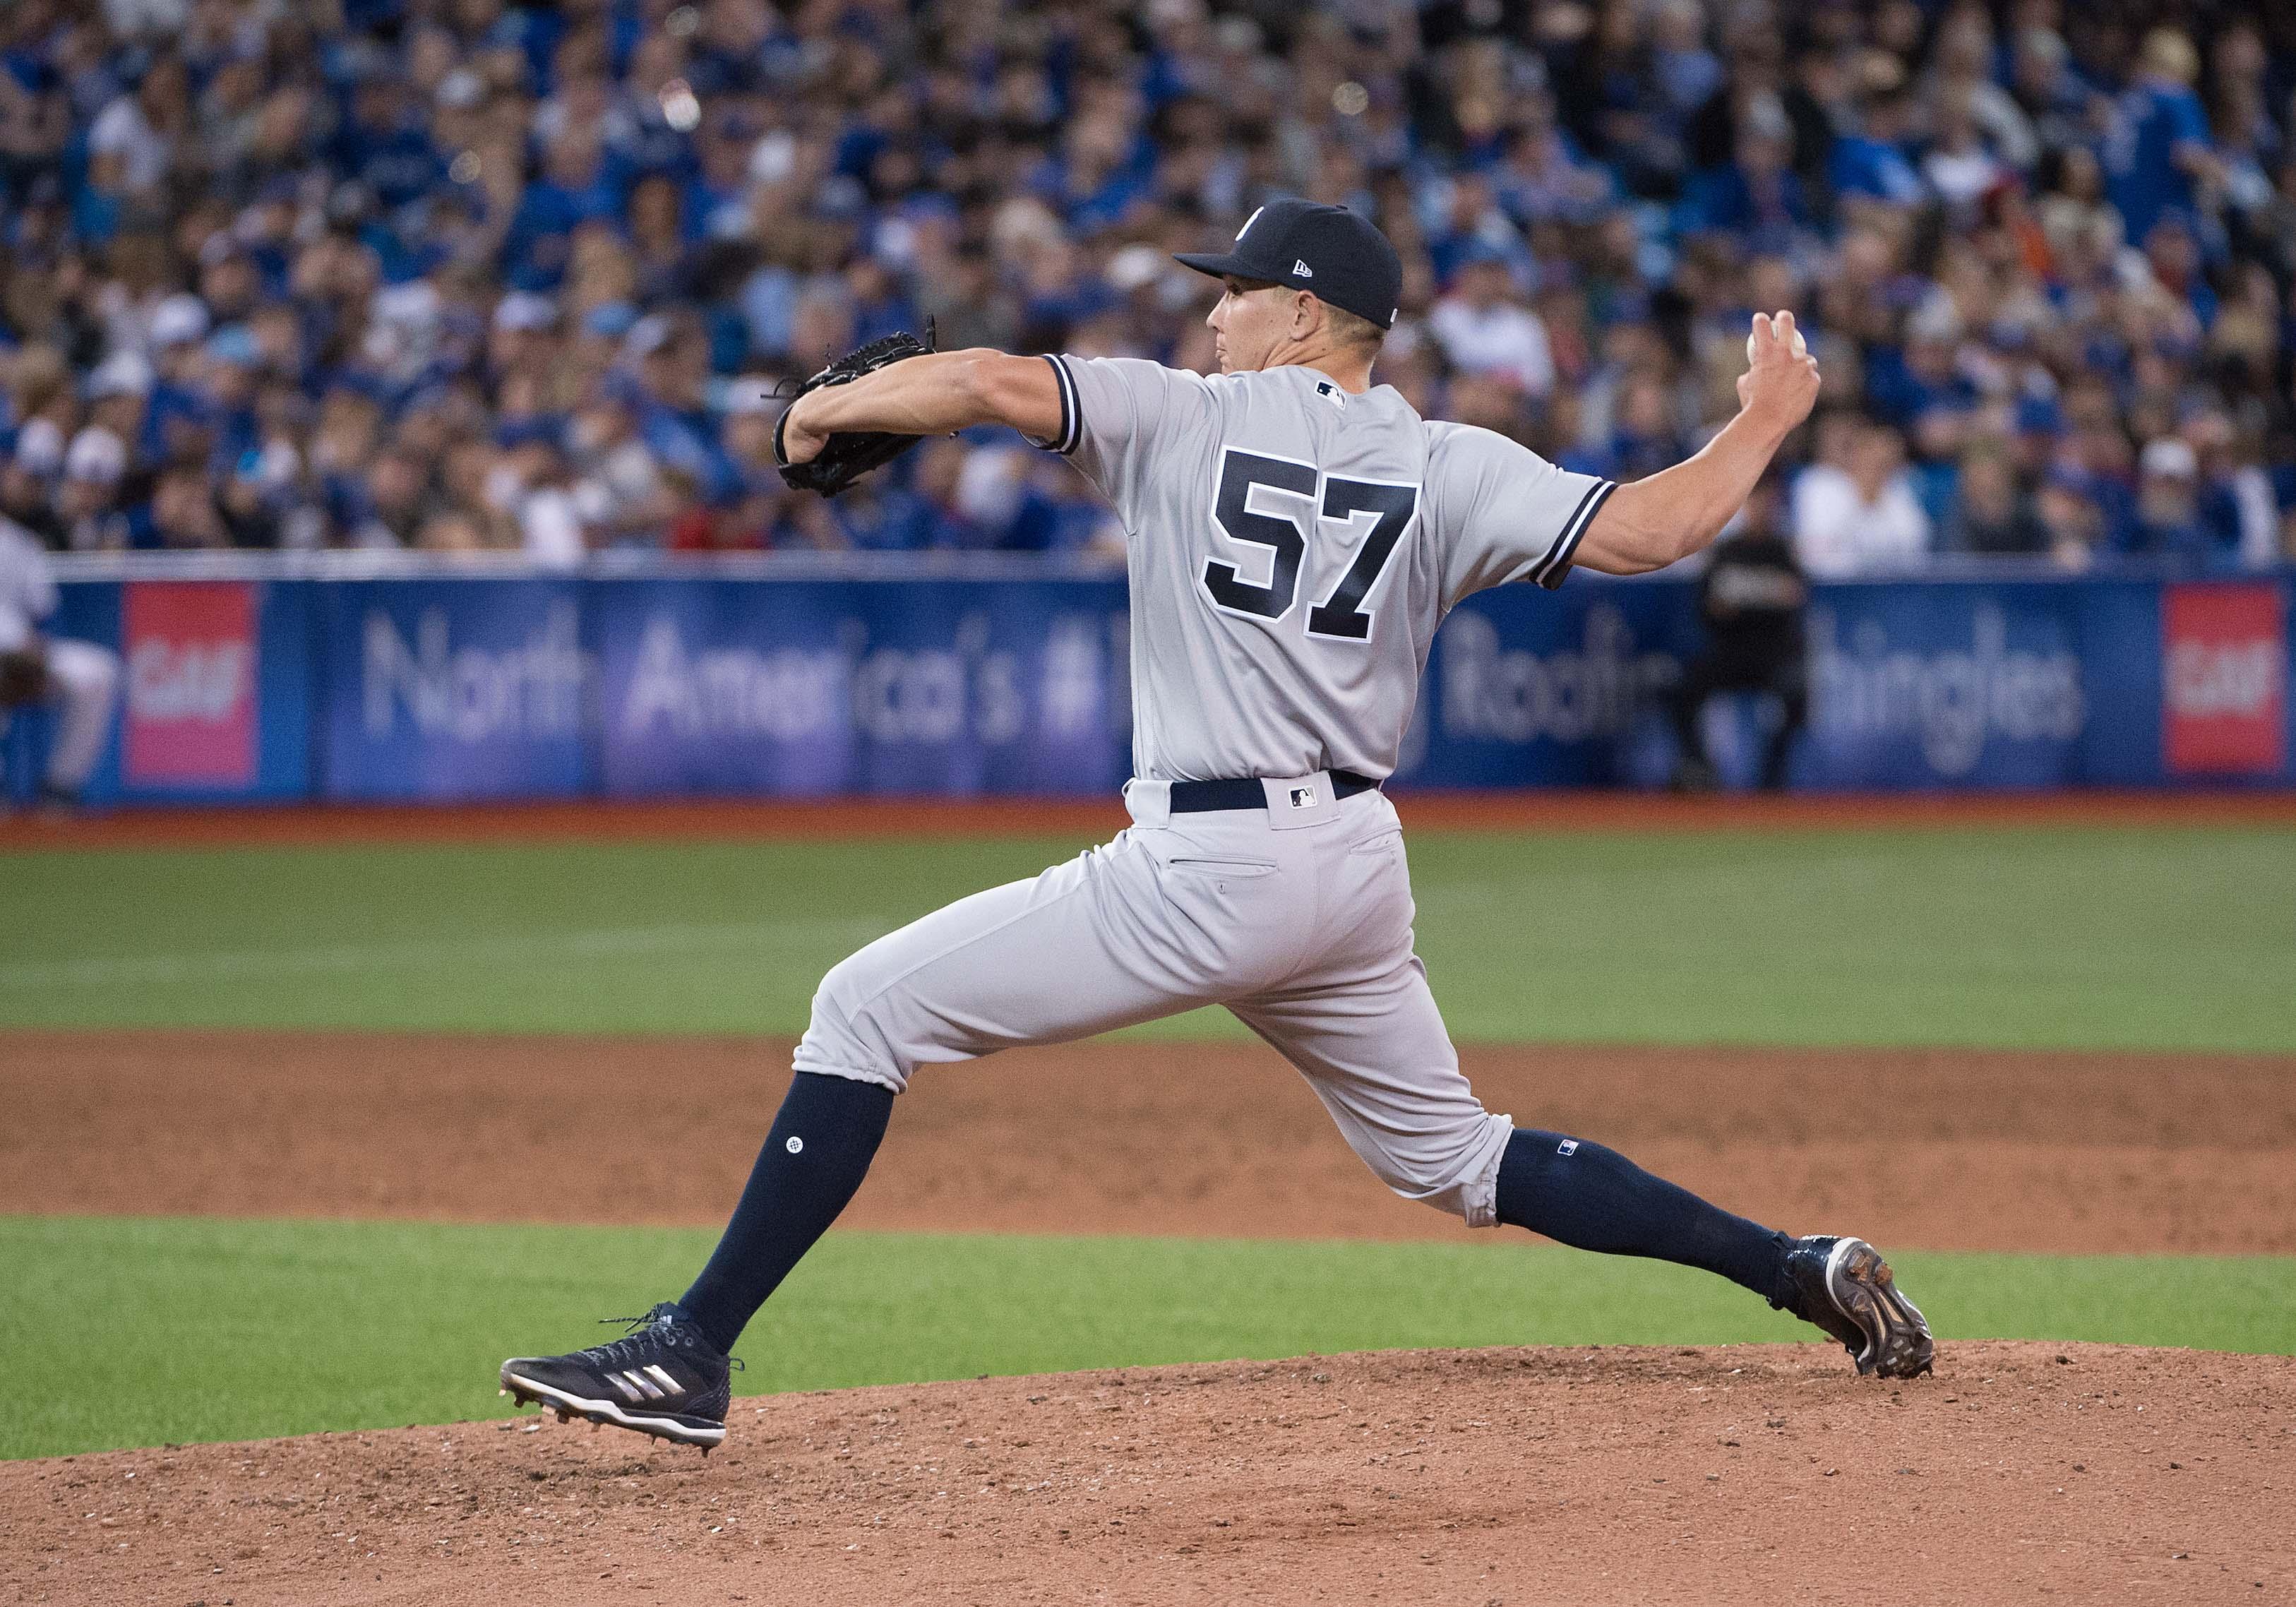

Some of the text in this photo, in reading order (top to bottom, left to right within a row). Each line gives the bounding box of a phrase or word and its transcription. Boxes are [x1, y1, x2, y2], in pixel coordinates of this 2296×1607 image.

[1200, 445, 1423, 645] 57
[363, 602, 597, 743] North
[620, 611, 1025, 746] America's
[1804, 600, 2084, 775] hingles
